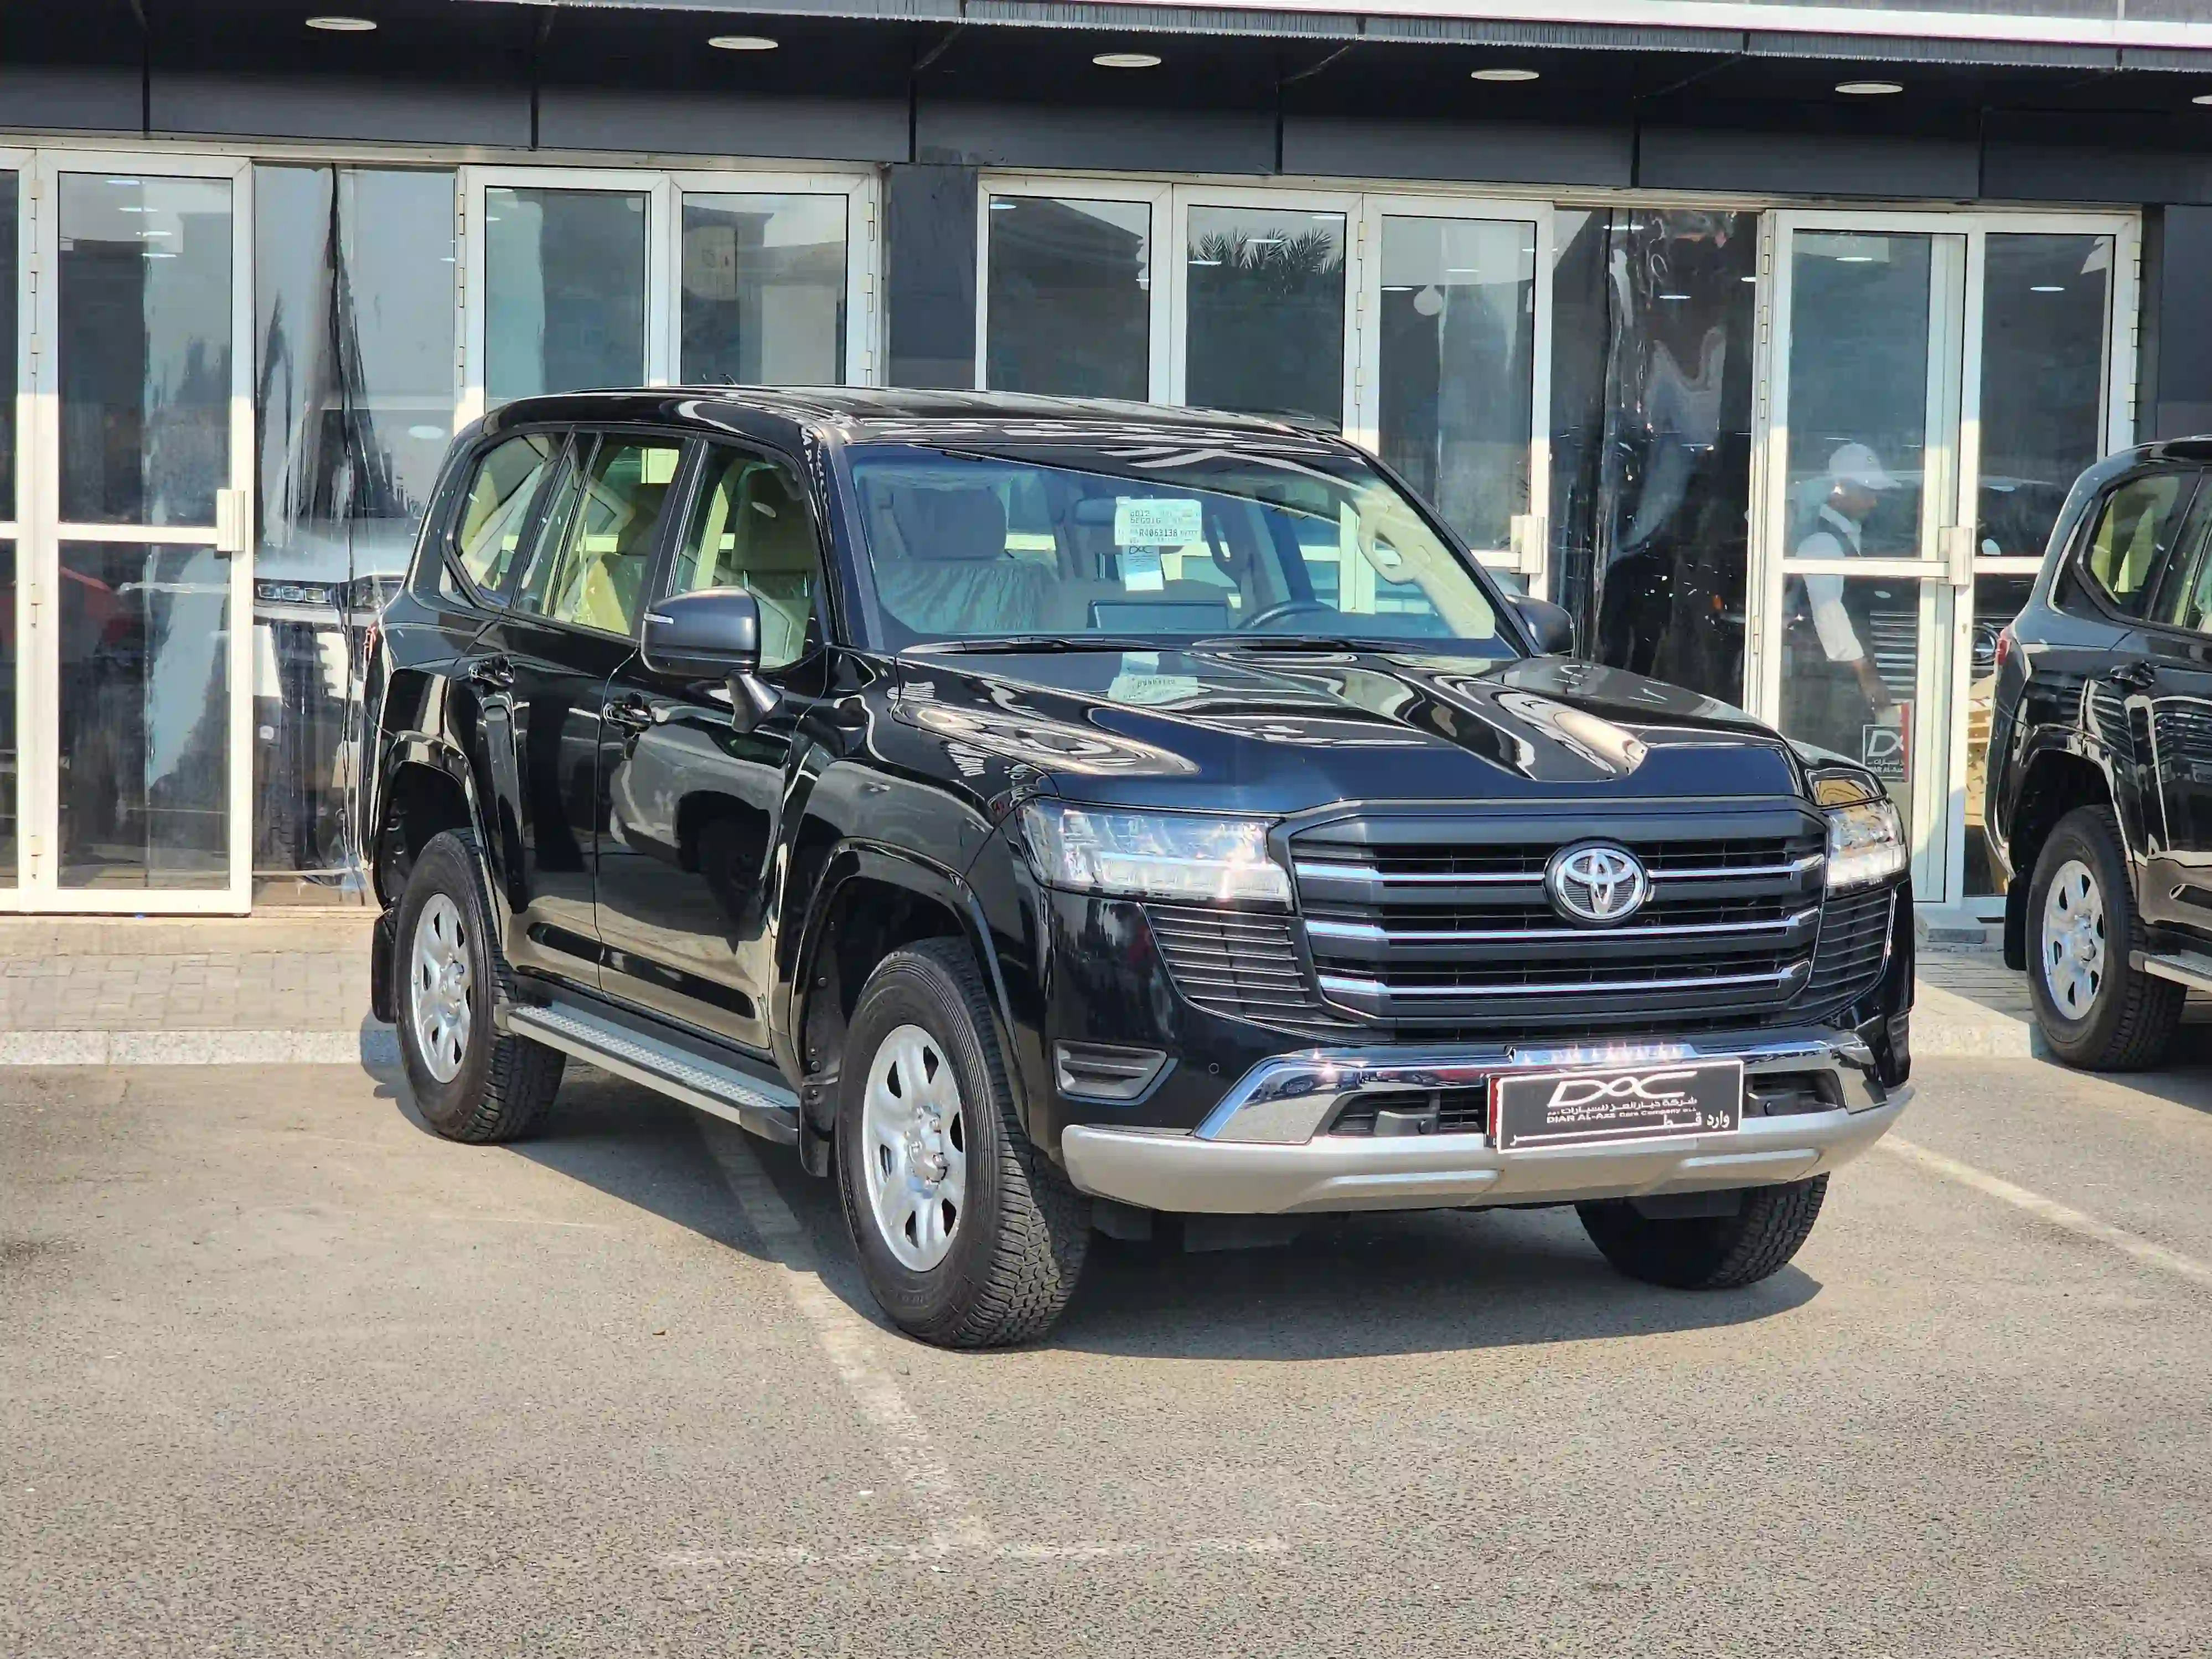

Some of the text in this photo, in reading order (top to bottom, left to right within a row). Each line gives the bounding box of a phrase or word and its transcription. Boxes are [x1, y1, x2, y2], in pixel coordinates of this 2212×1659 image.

[1547, 1116, 1575, 1124] DIAR
[1641, 1108, 1681, 1116] Company
[1707, 1110, 1730, 1129] وارد
